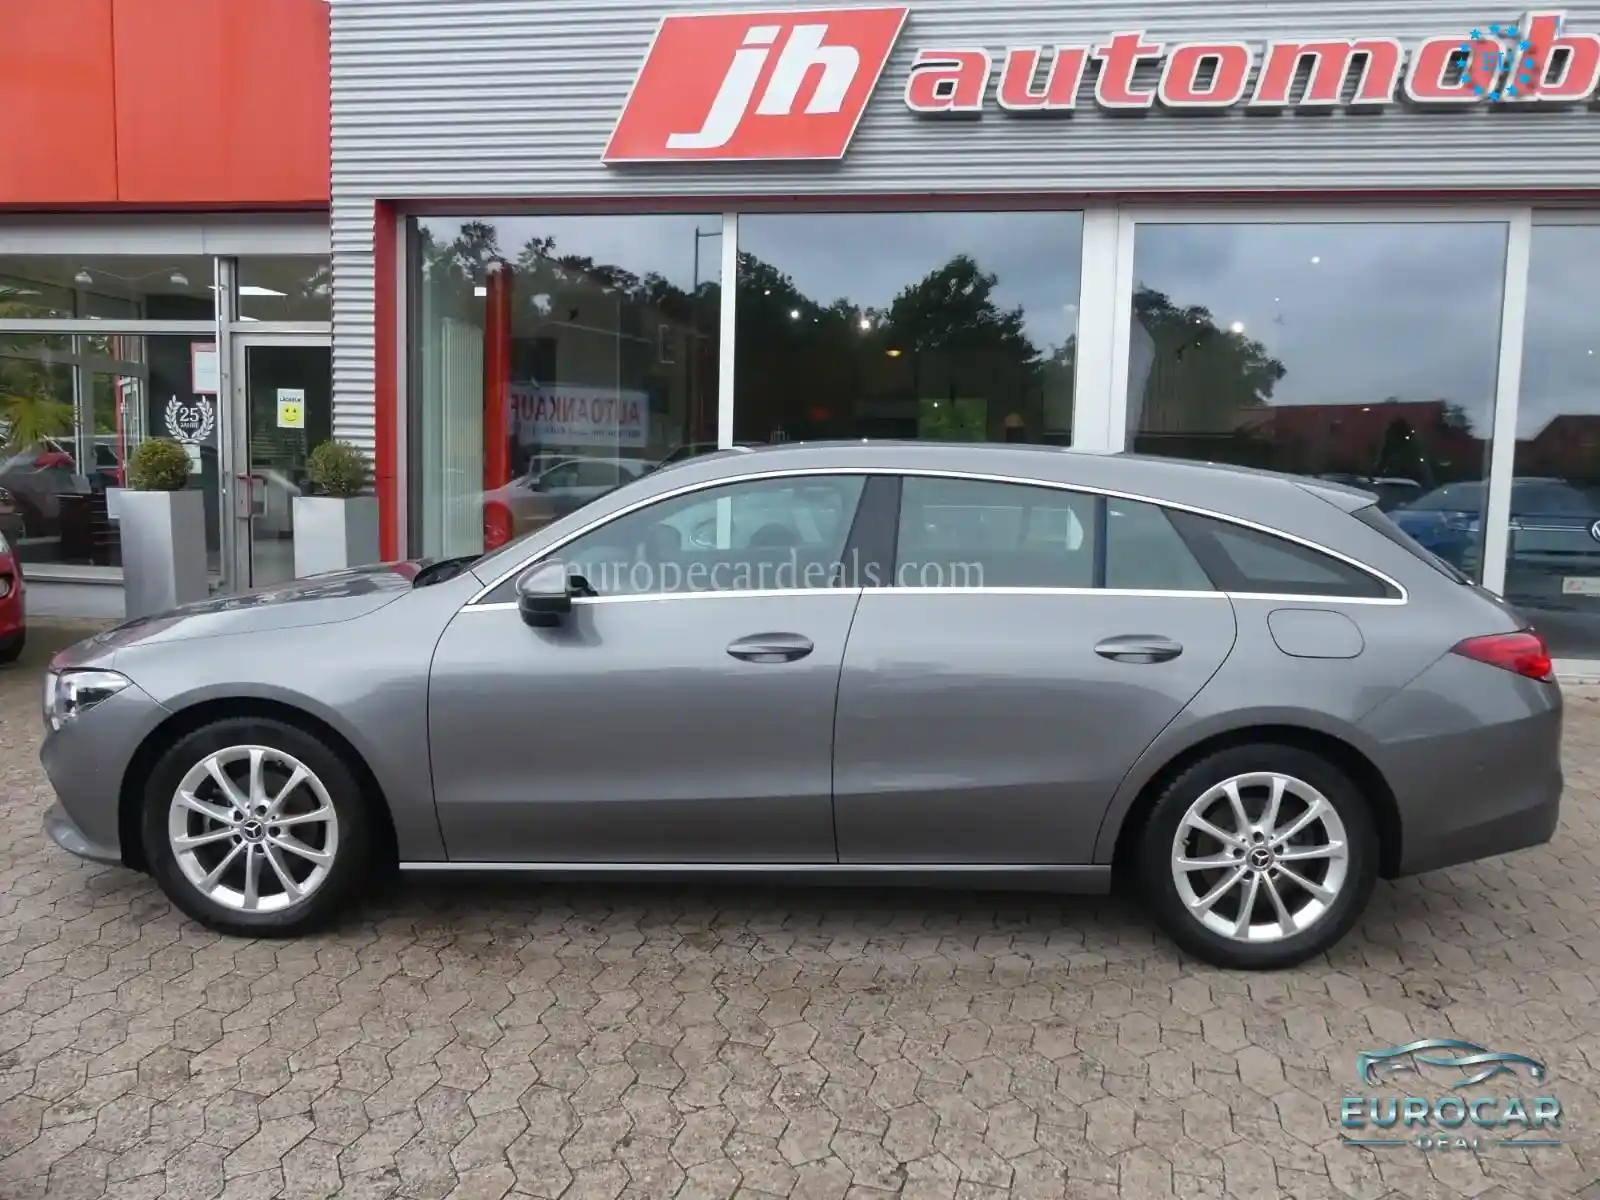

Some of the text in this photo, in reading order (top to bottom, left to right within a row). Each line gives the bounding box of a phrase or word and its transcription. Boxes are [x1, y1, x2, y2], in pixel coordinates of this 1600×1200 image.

[665, 11, 1600, 149] jh automob
[180, 407, 199, 422] 25
